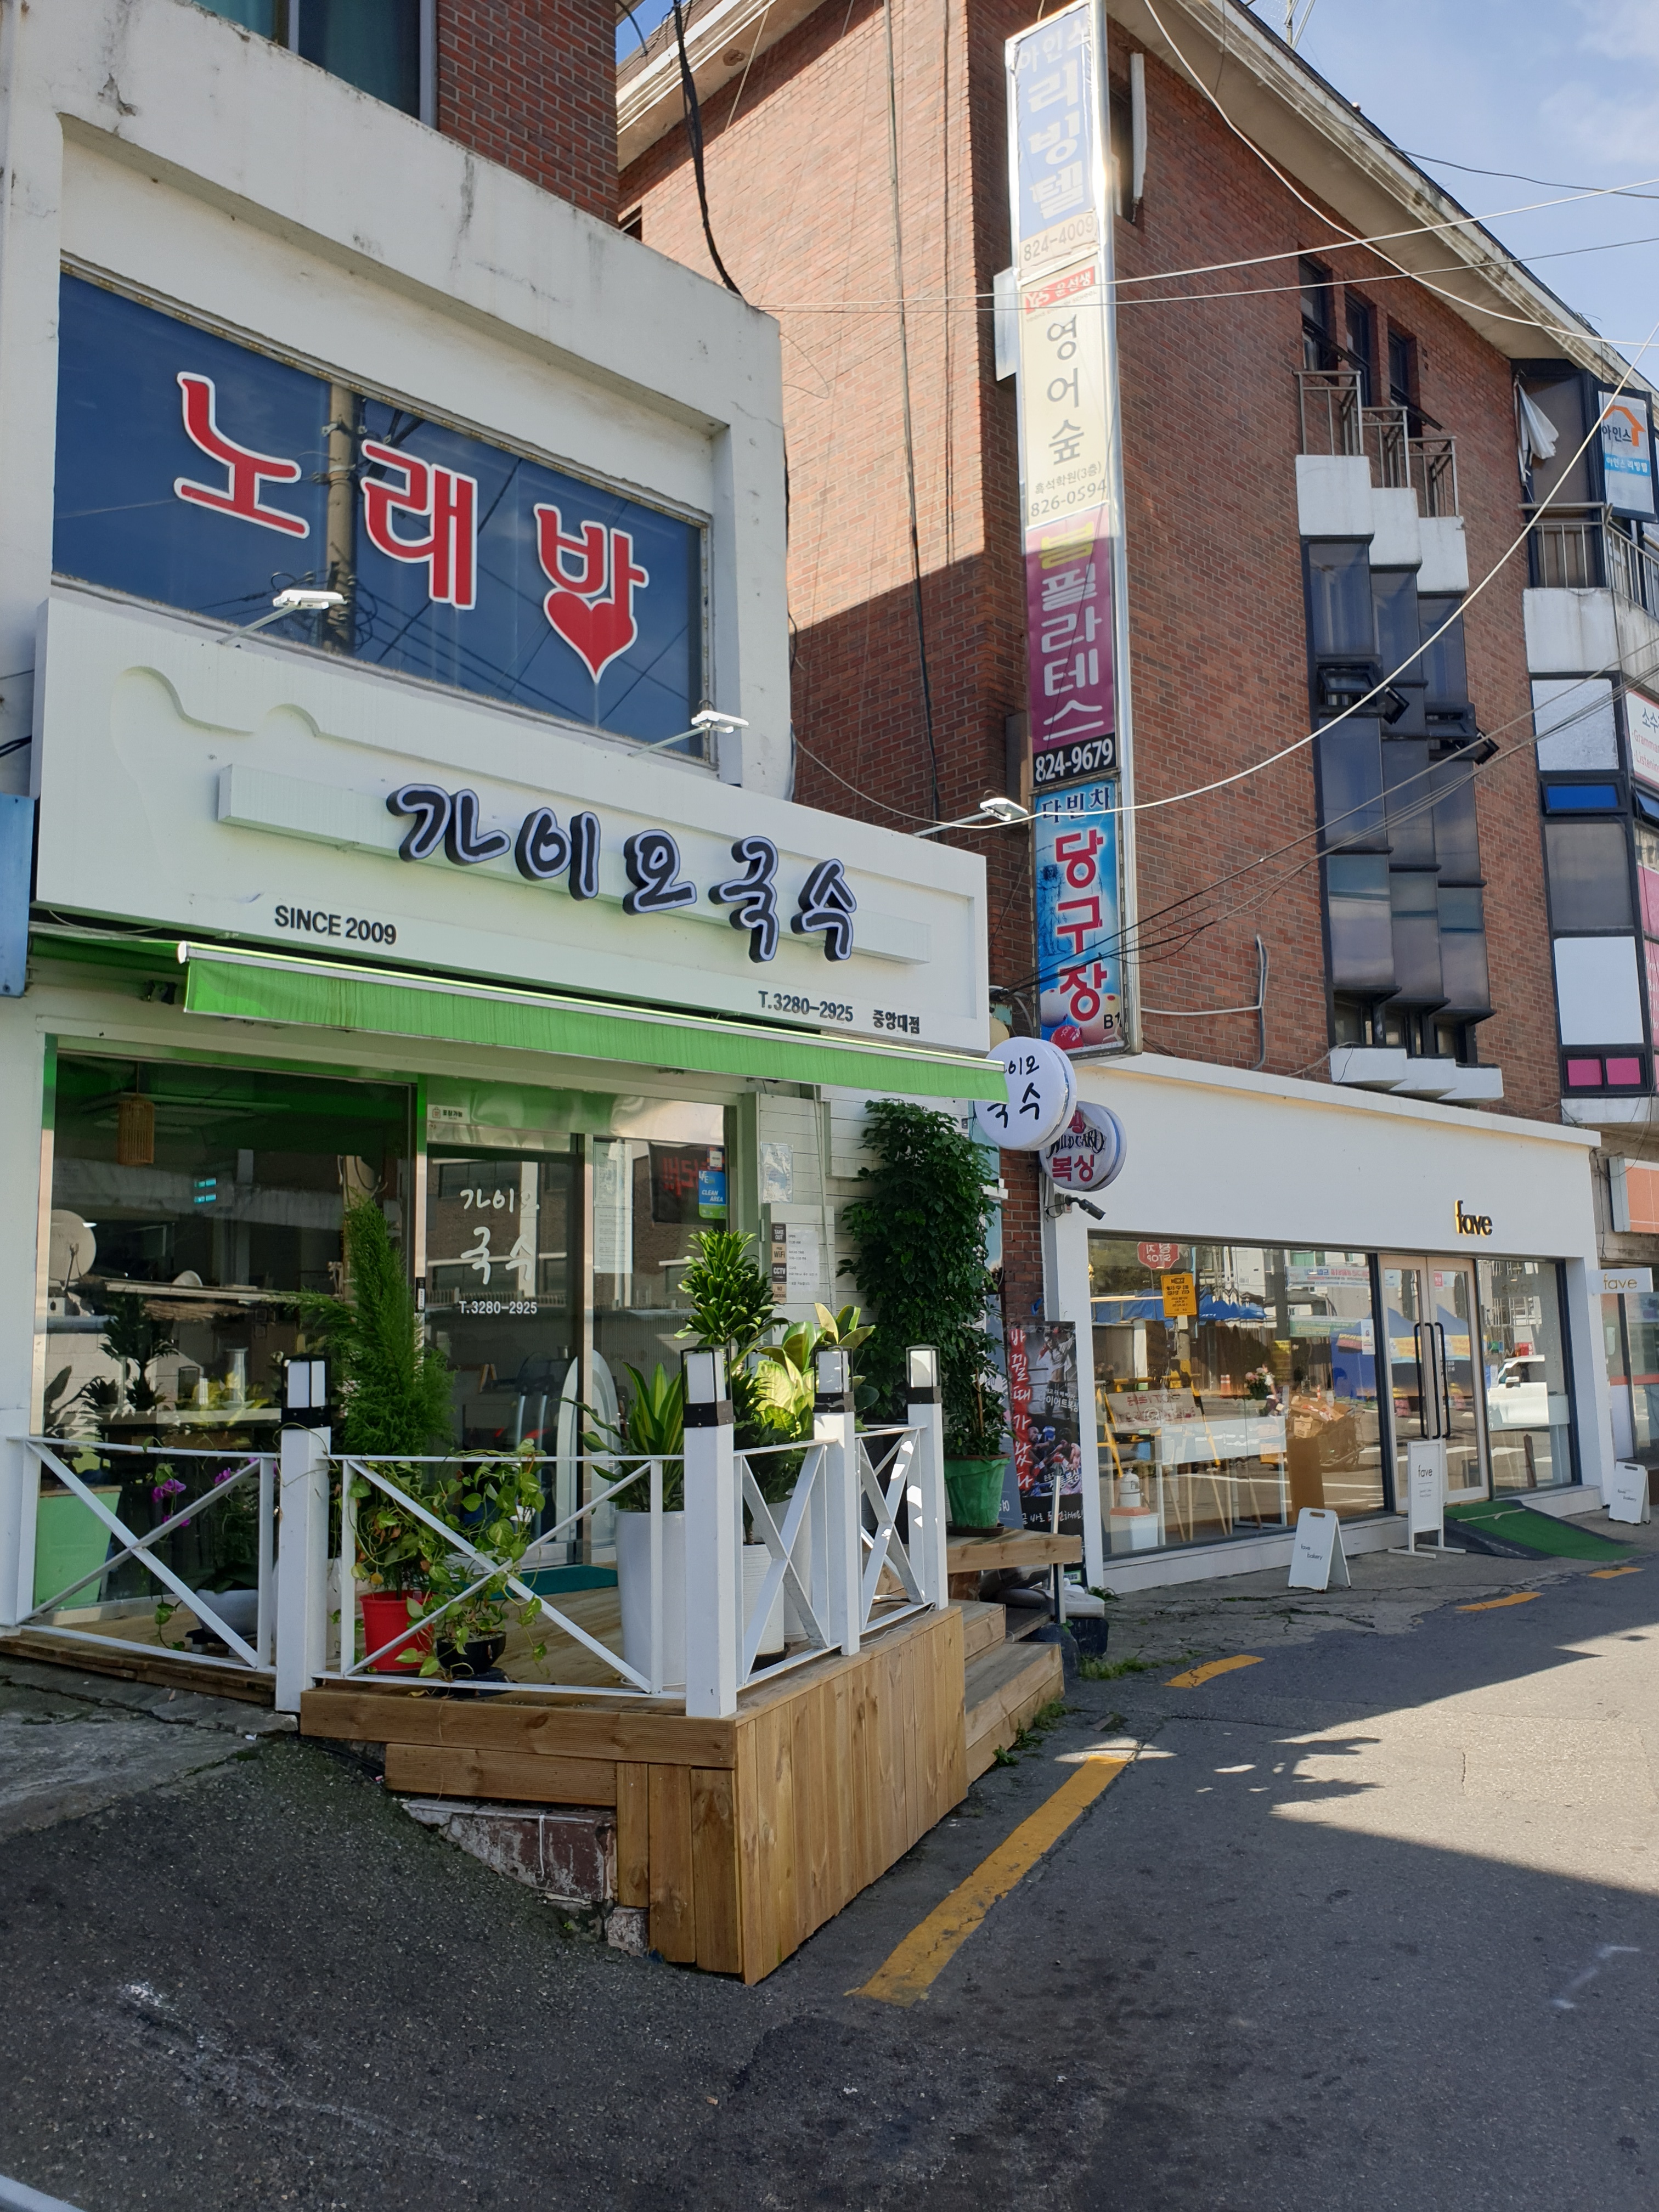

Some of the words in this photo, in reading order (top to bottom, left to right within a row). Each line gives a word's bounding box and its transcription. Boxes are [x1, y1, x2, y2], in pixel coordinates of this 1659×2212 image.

[1027, 59, 1084, 219] 리빙텔
[1024, 215, 1094, 262] 824-4009
[1054, 270, 1092, 297] 윤선생
[1046, 314, 1085, 465] 영어숲
[1601, 424, 1632, 442] 아인스
[1031, 478, 1107, 517] 826-0594
[173, 371, 650, 684] 노래방
[1641, 707, 1659, 734] 소수
[1035, 738, 1113, 782] 824-9679
[1041, 787, 1110, 823] 다빈치
[275, 905, 341, 936] SINCE
[346, 917, 397, 946] 2009
[1056, 829, 1108, 1022] 당구장
[758, 990, 854, 1023] T.3280-2925
[872, 1009, 921, 1035] 중앙대점
[1003, 1055, 1040, 1075] 이오
[1052, 1154, 1095, 1182] 복싱
[1454, 1200, 1493, 1235] fave
[460, 1226, 533, 1285] 국수
[1603, 1273, 1638, 1290] fave
[459, 1301, 538, 1314] T.3280-2925
[1418, 1464, 1433, 1477] fave
